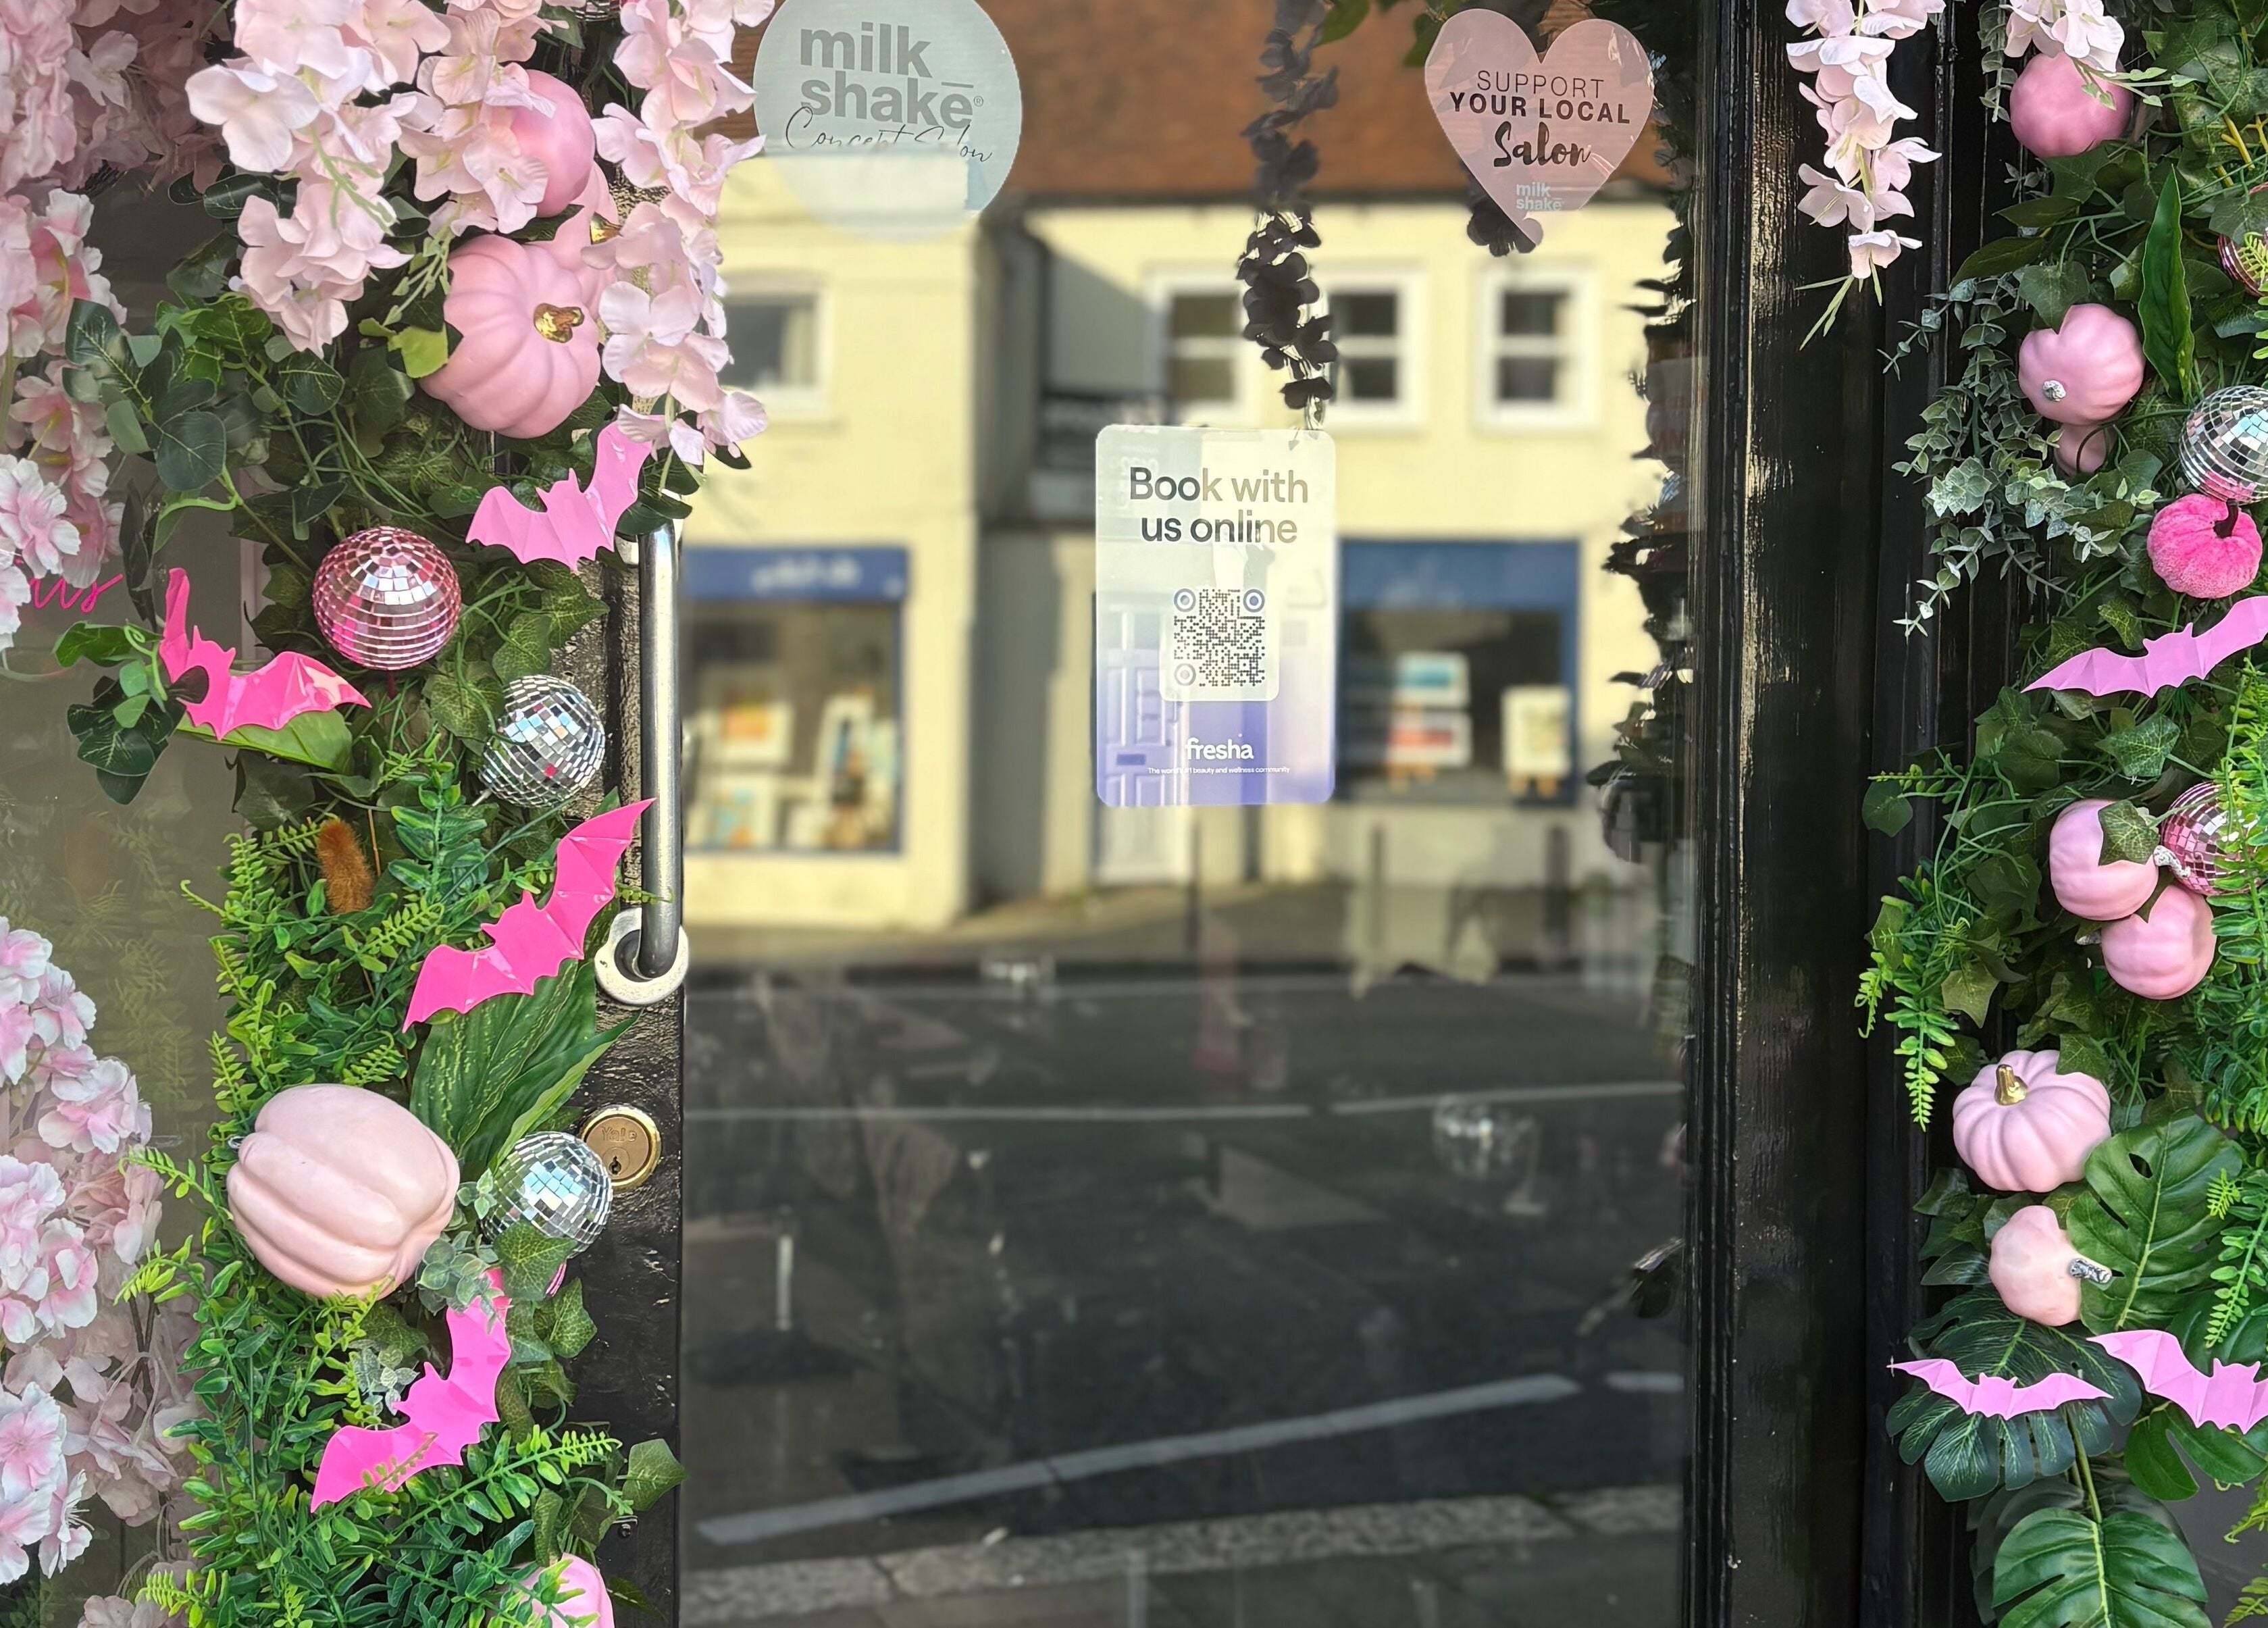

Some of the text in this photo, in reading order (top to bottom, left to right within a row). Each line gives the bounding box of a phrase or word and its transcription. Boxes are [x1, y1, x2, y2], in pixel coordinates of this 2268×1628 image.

[1477, 70, 1605, 99] SUPPORT
[1450, 91, 1630, 124] YOUR LOCAL
[1493, 121, 1592, 168] Salon
[1516, 181, 1551, 198] milk
[1130, 467, 1308, 503] Book with
[1141, 509, 1298, 544] us online
[1184, 736, 1254, 761] fresha
[1148, 767, 1160, 775] The
[1193, 767, 1214, 775] beauty
[1229, 766, 1254, 774] wellness
[1255, 766, 1291, 774] community
[600, 1125, 638, 1143] Yale
